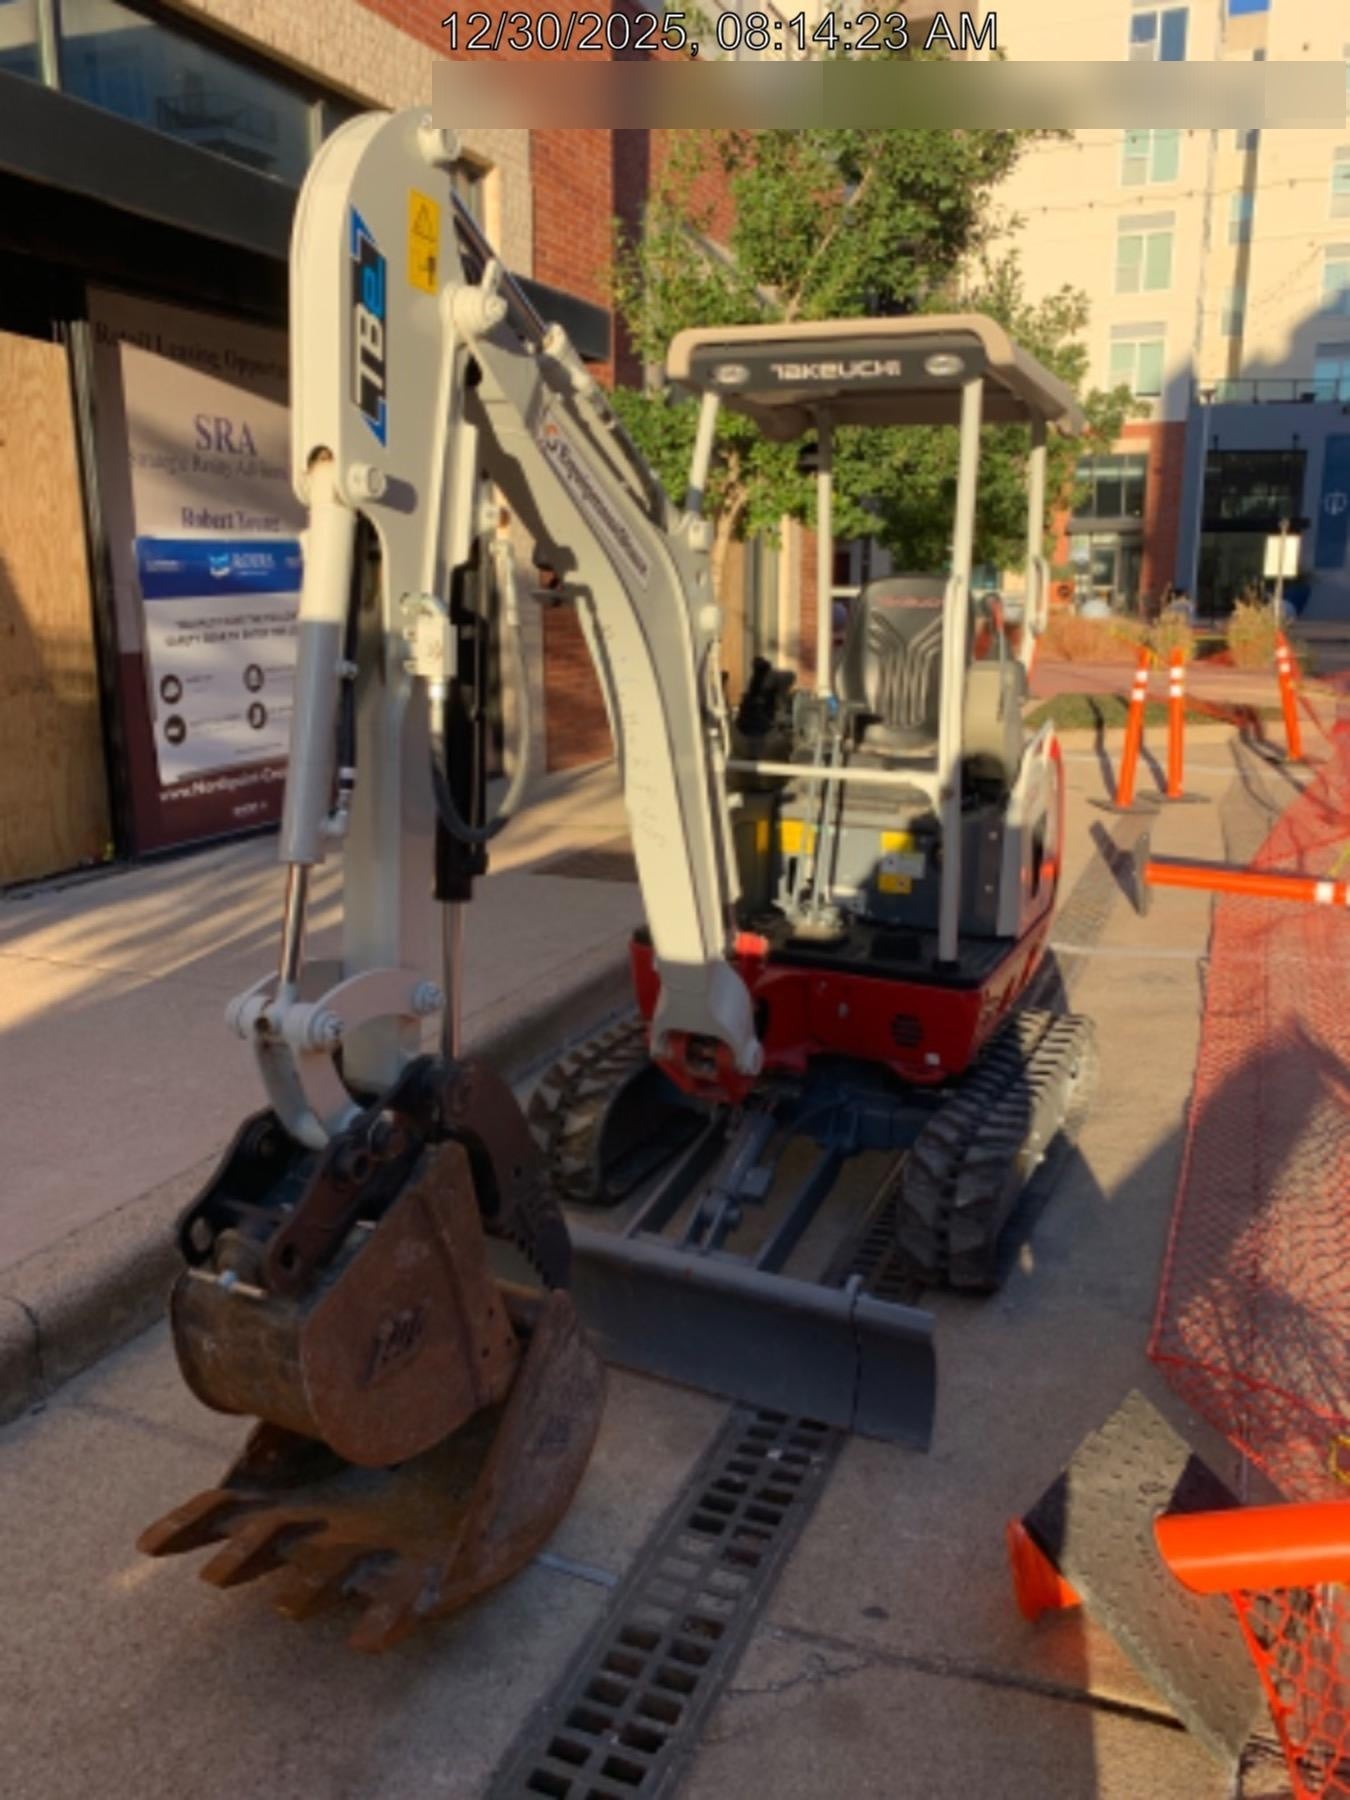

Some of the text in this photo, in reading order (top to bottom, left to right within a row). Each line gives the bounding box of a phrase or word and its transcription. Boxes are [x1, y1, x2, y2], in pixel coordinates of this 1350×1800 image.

[769, 359, 902, 382] TAKEUCHI
[194, 413, 257, 456] SRA
[181, 505, 234, 530] Robert
